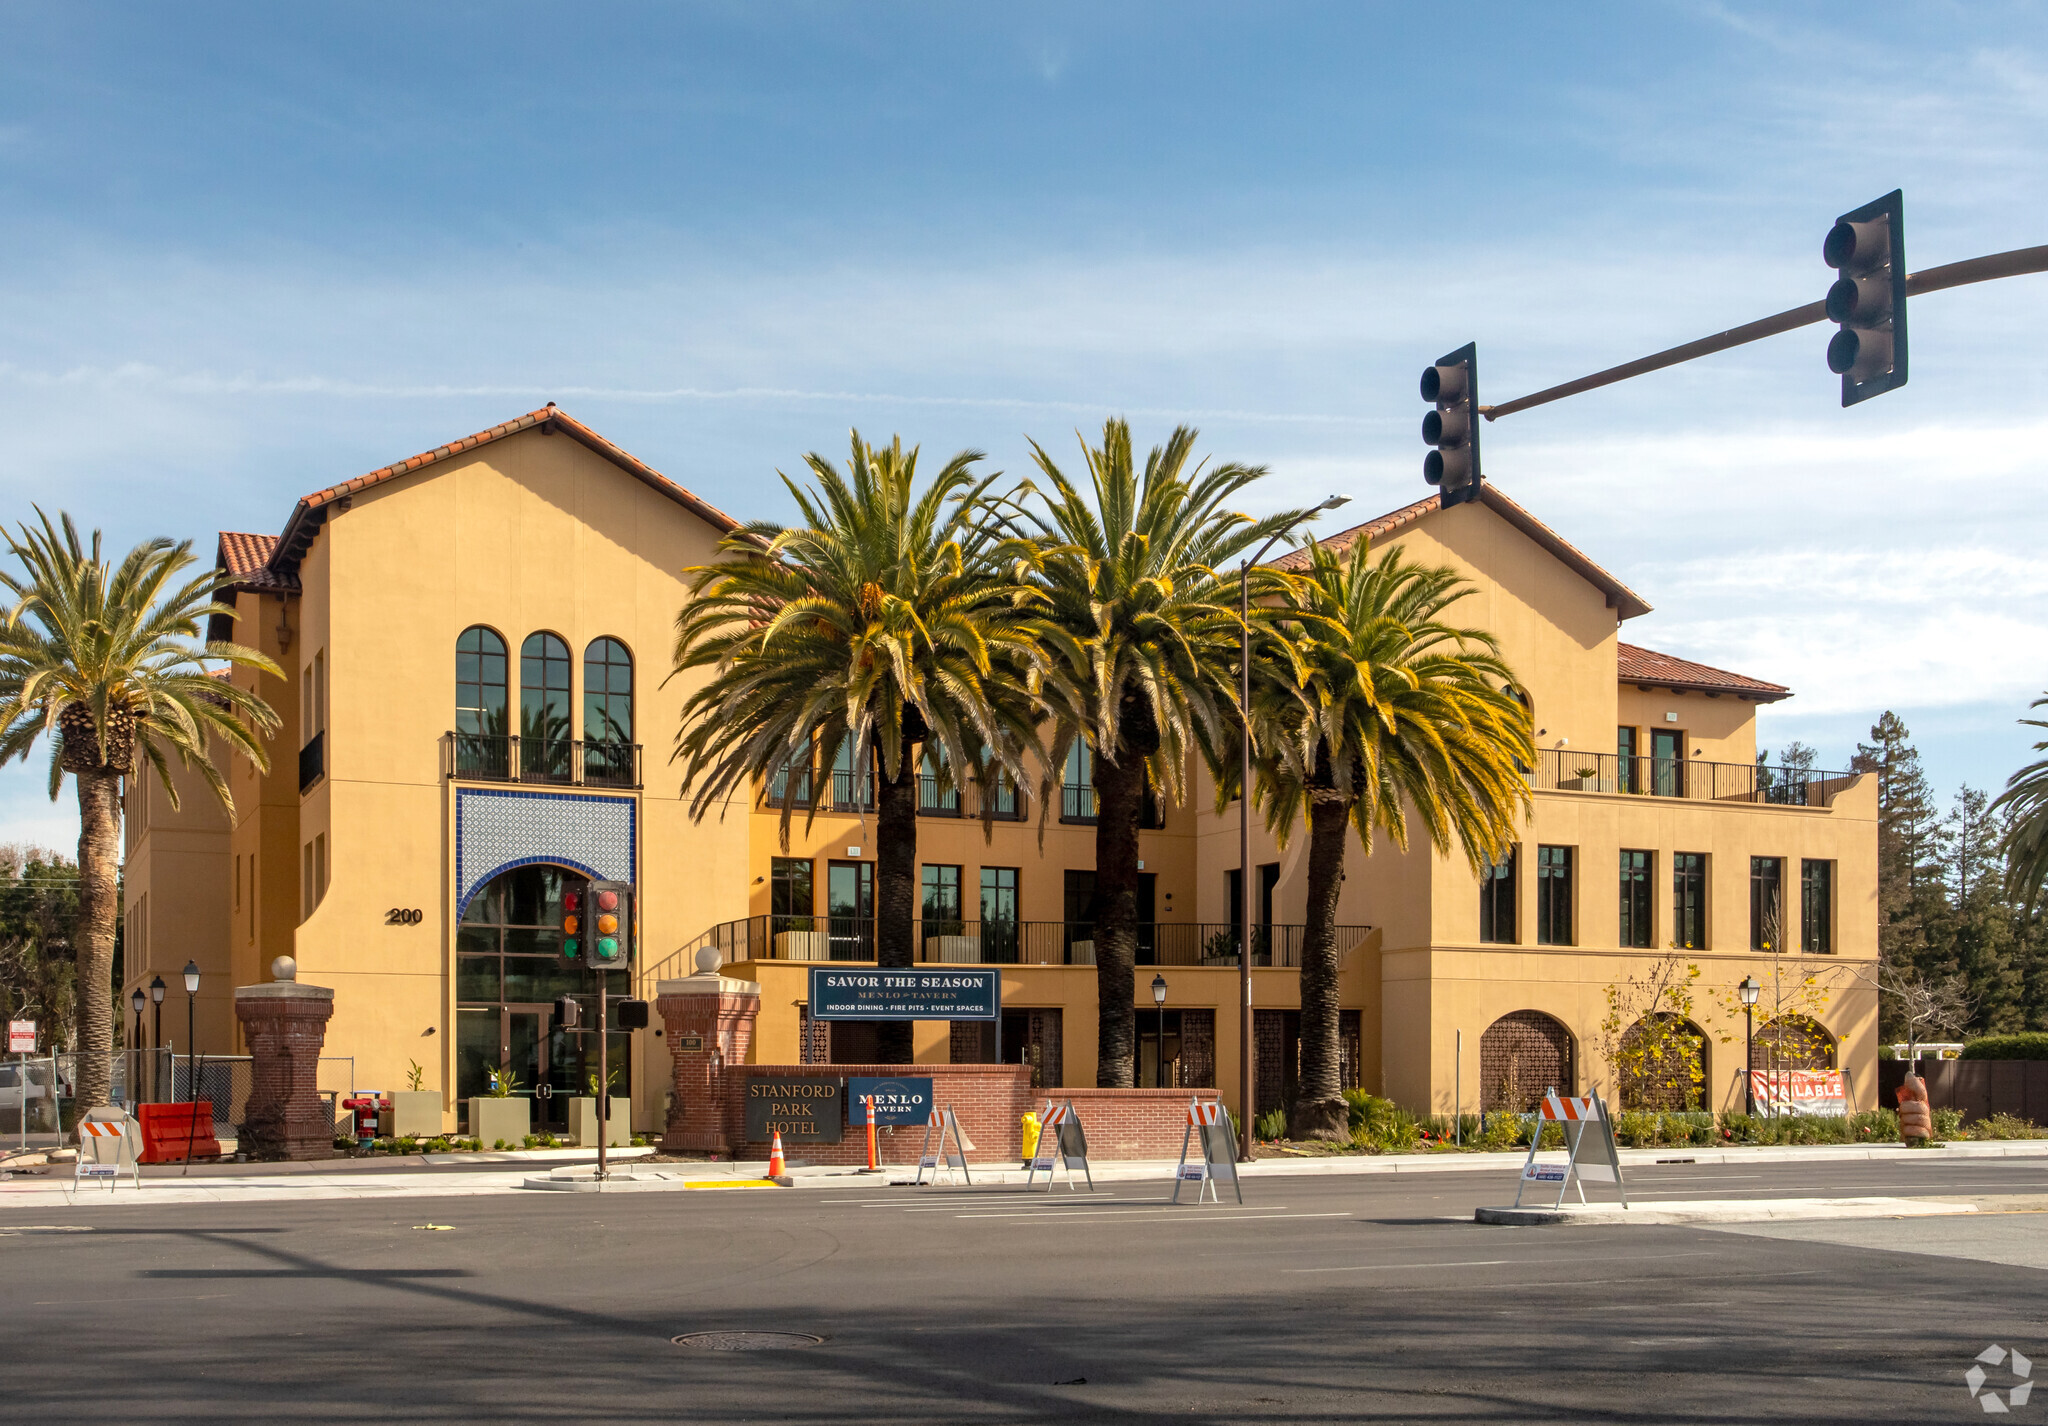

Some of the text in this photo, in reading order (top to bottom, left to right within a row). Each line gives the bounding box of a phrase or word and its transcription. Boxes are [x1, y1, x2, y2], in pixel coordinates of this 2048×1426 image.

[389, 908, 423, 923] 200
[827, 976, 984, 988] SAVOR THE SEASON
[751, 1084, 835, 1098] STANFORD
[1758, 1084, 1841, 1097] AVAILABLE
[772, 1103, 813, 1116] PARK
[766, 1121, 820, 1134] HOTEL
